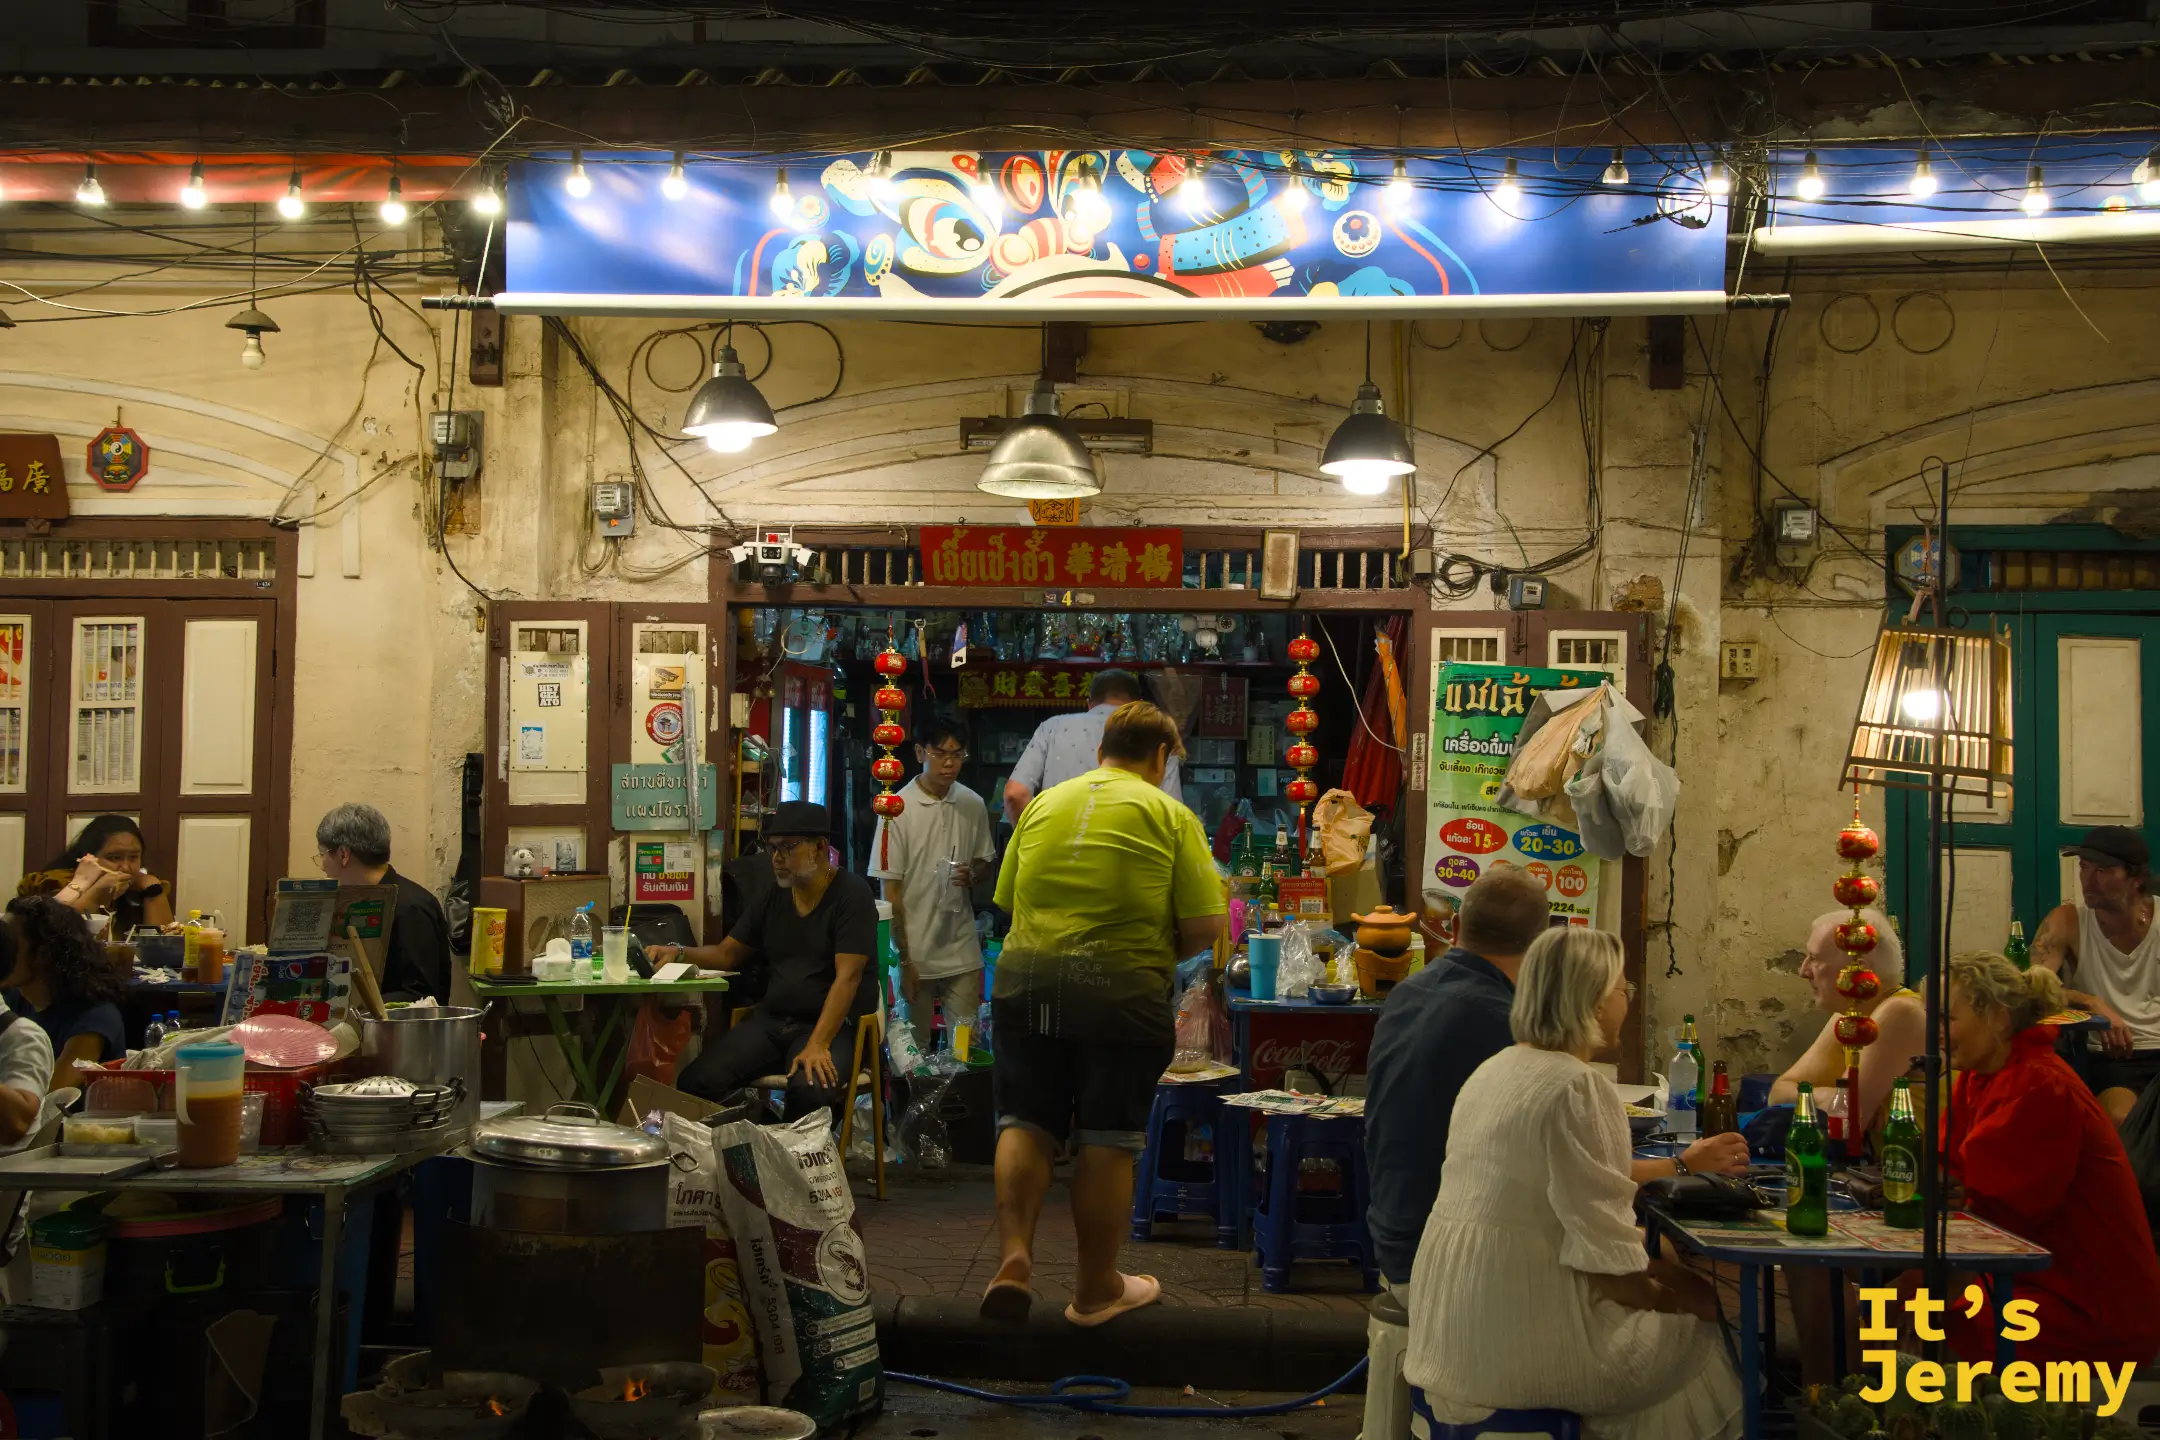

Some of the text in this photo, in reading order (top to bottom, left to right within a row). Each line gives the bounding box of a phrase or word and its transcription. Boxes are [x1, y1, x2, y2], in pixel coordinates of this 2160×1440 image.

[1061, 590, 1073, 606] 4
[540, 691, 560, 699] GEL
[1444, 730, 1513, 755] เครื่องดื่ม
[1466, 820, 1484, 831] ร้อน
[1446, 832, 1472, 844] แก้วละ
[1437, 867, 1476, 881] 30-40
[1559, 875, 1585, 890] 100
[1069, 961, 1102, 973] YOUR
[1067, 973, 1111, 987] HEALTH
